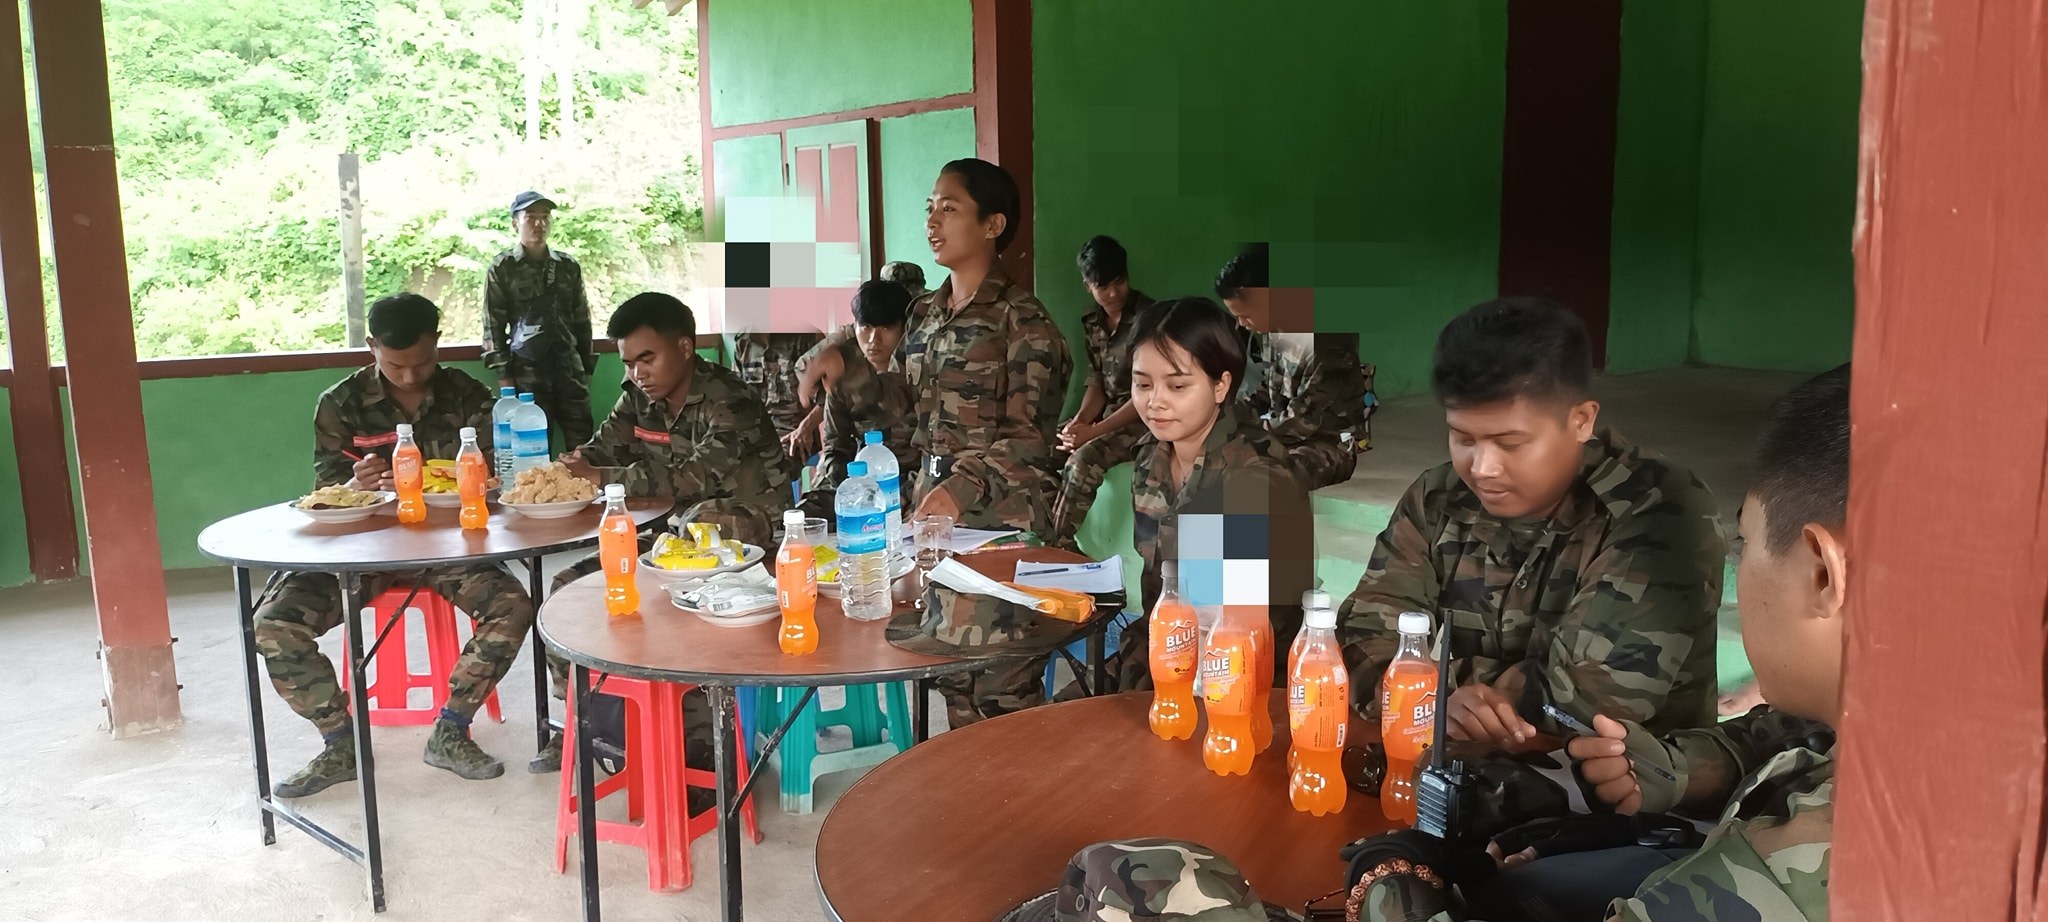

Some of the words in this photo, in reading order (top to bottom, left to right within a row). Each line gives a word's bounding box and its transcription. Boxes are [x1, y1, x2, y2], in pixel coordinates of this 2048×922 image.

[1166, 626, 1196, 648] BLUE
[1203, 657, 1230, 672] BLUE
[1203, 669, 1230, 678] OUNTAIN
[1413, 700, 1436, 720] BL
